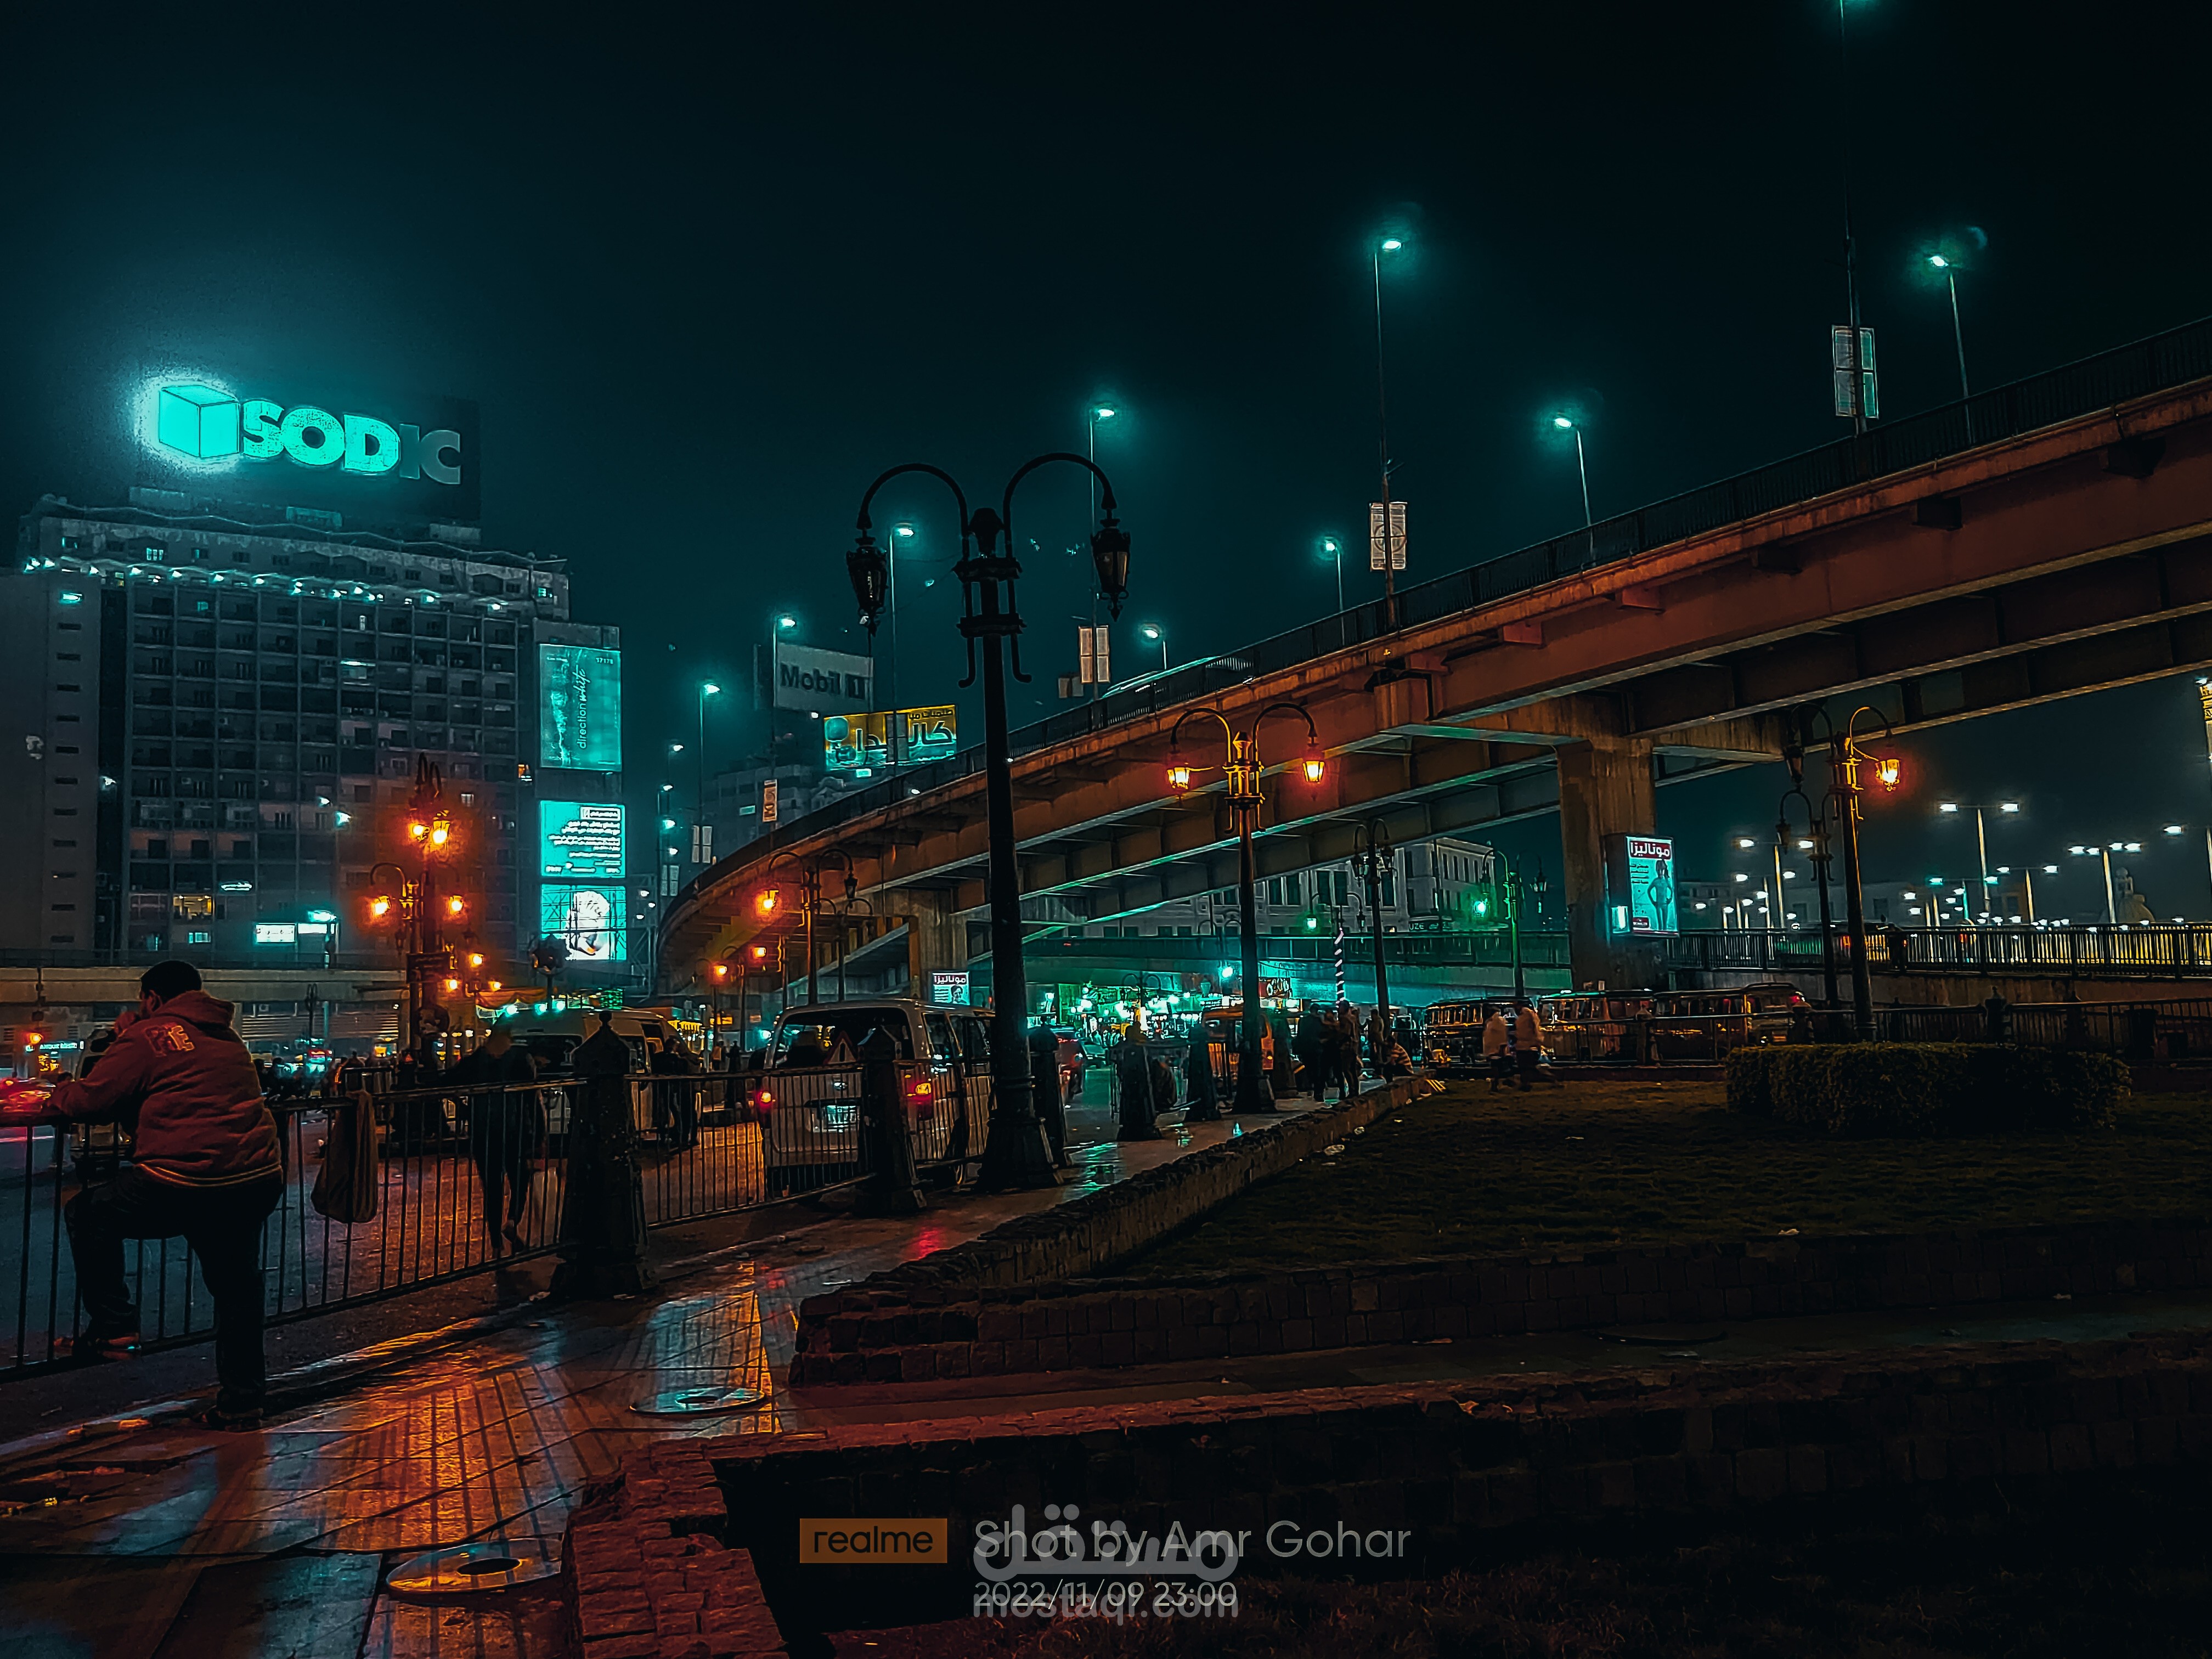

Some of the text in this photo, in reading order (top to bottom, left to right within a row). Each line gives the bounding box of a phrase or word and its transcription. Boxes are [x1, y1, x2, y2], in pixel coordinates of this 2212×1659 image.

[242, 399, 461, 485] SODIC
[780, 662, 840, 695] Mobil
[572, 668, 591, 749] direction white
[1630, 842, 1671, 857] موناليزا
[934, 975, 966, 984] موناليزا
